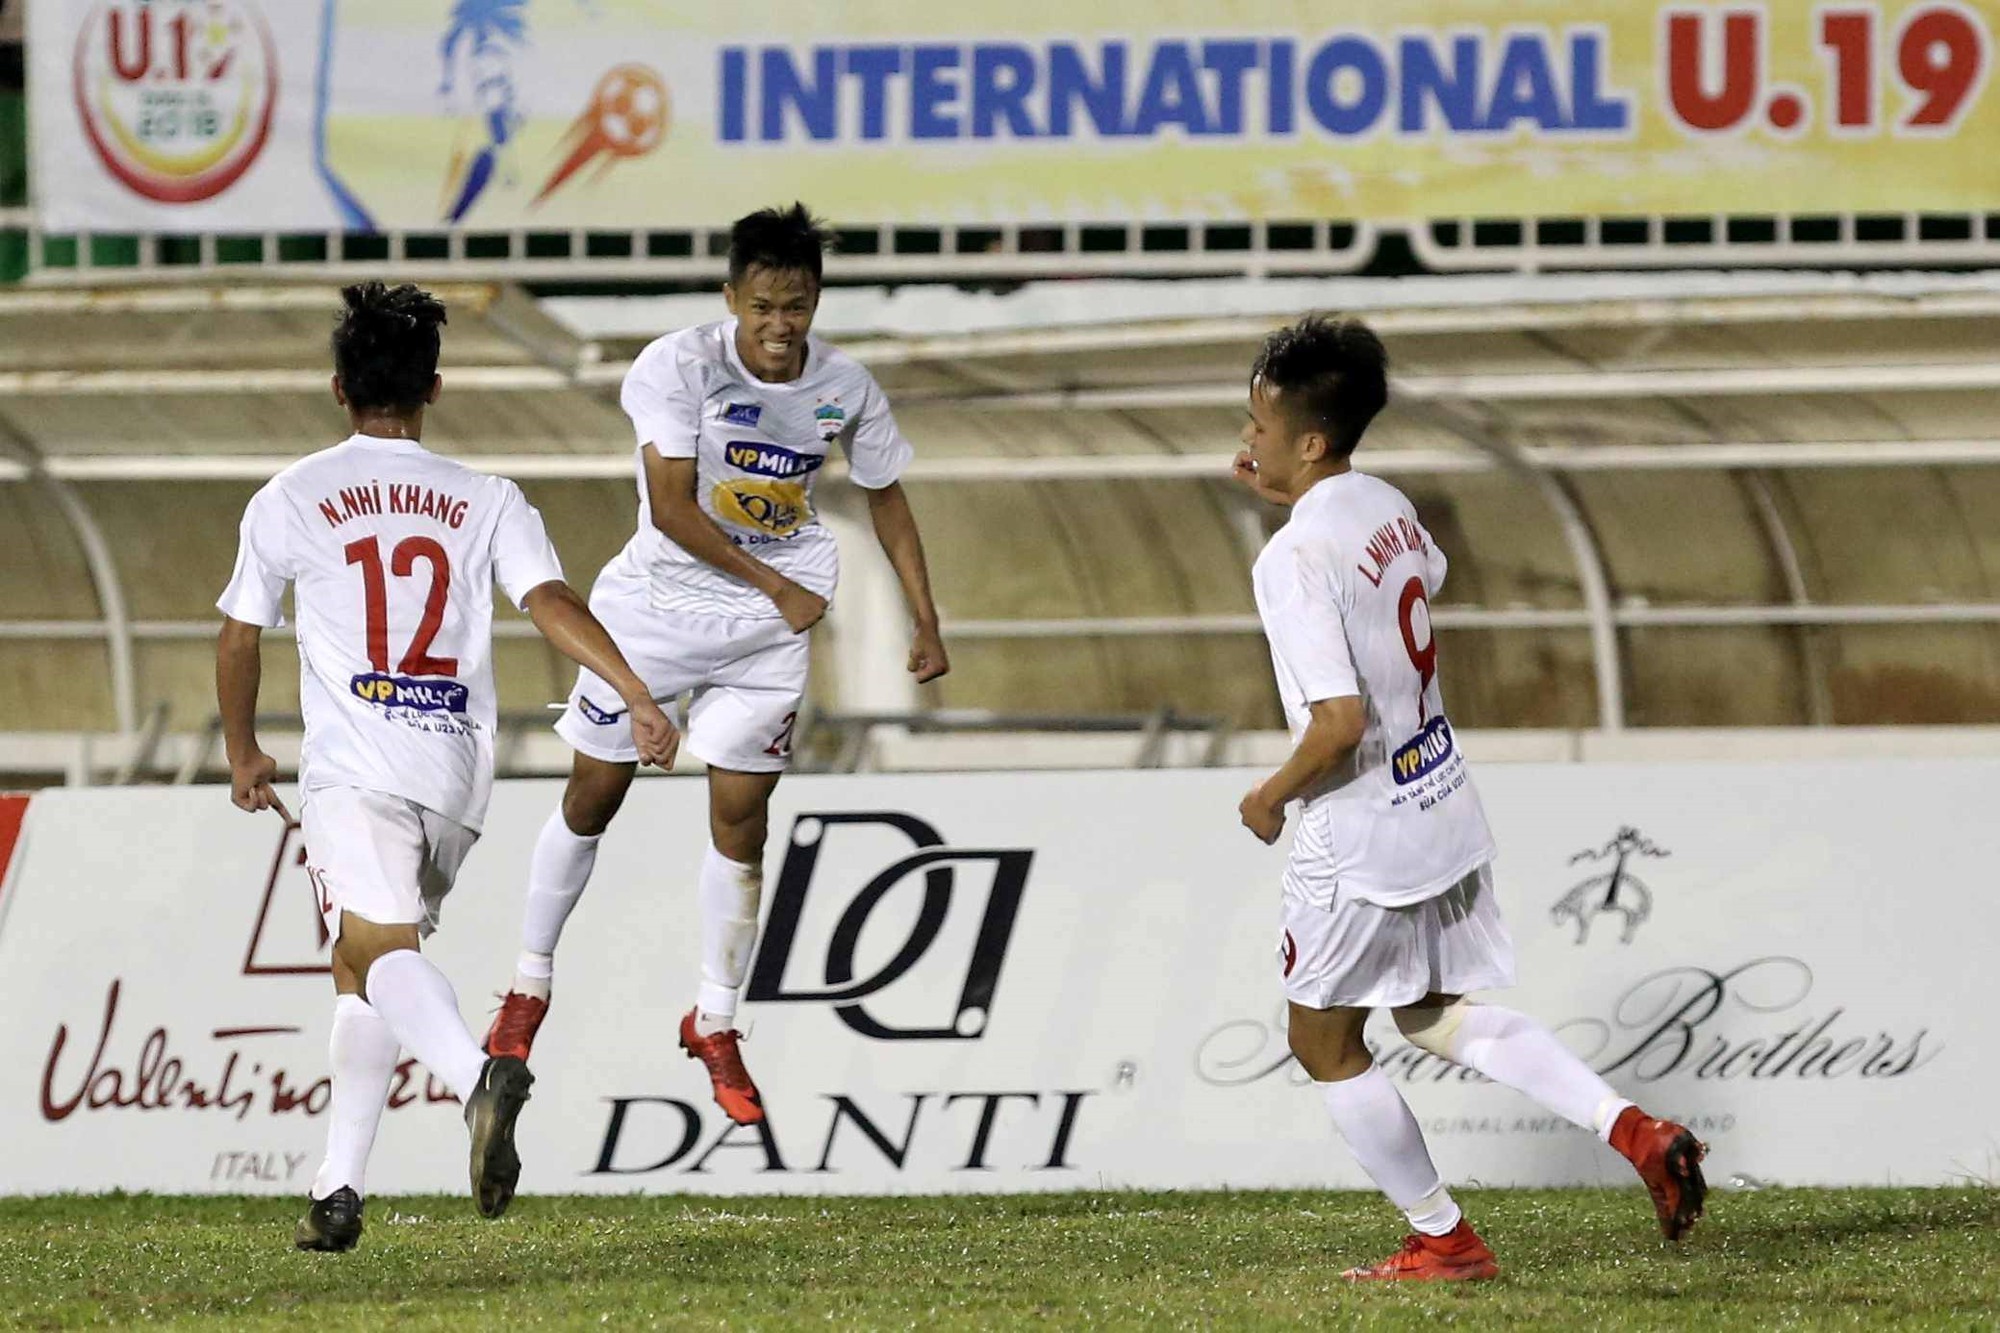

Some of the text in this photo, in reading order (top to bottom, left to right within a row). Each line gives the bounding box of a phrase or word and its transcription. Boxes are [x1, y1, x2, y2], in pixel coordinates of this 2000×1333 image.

[719, 8, 1983, 142] INTERNATIONAL U.19
[389, 483, 469, 530] KHANG
[344, 535, 458, 678] 12
[1398, 576, 1438, 731] 9
[1560, 956, 1946, 1084] Brothers
[208, 1150, 308, 1181] ITALY
[580, 1088, 1101, 1175] DANTI
